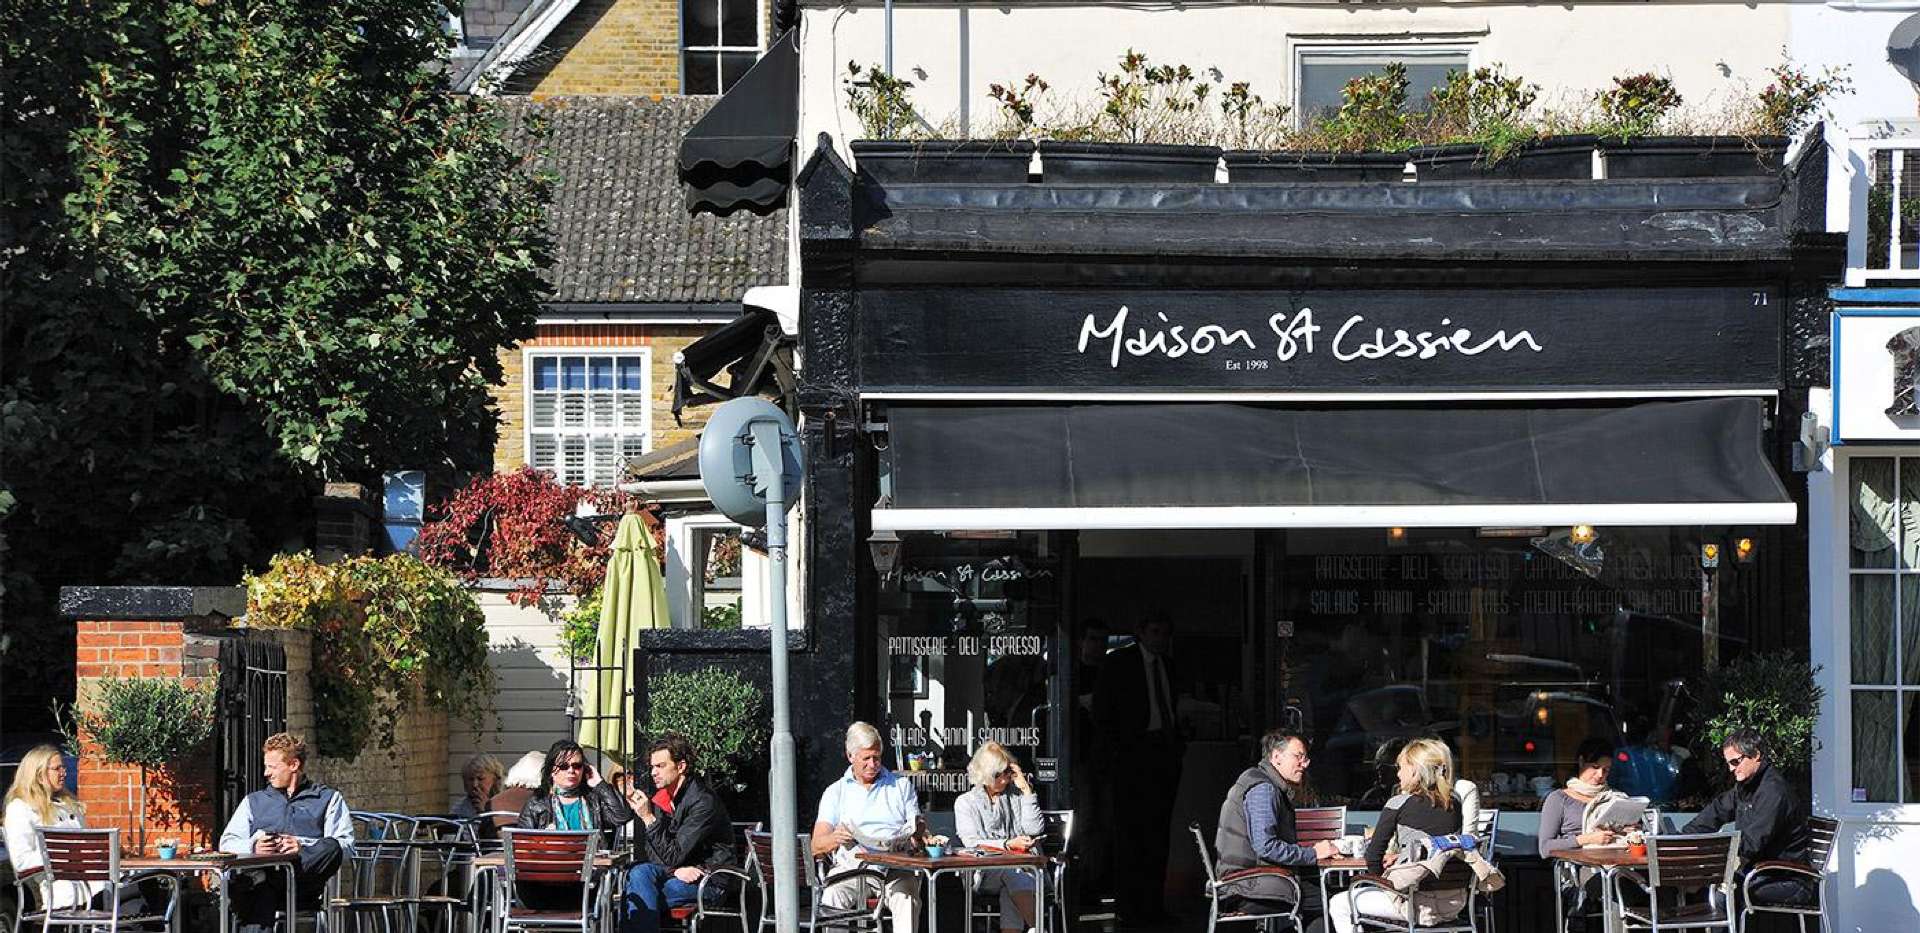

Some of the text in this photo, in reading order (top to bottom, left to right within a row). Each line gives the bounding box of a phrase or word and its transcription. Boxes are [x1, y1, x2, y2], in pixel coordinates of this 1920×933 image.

[1751, 292, 1768, 306] 71
[1077, 304, 1256, 369] Maison
[1331, 314, 1543, 362] Cassien
[1225, 359, 1269, 370] Est 1998
[1311, 590, 1360, 615] SALADS
[1373, 590, 1414, 615] PANINI
[958, 636, 979, 656] DELI
[990, 635, 1040, 656] ESPRESSO
